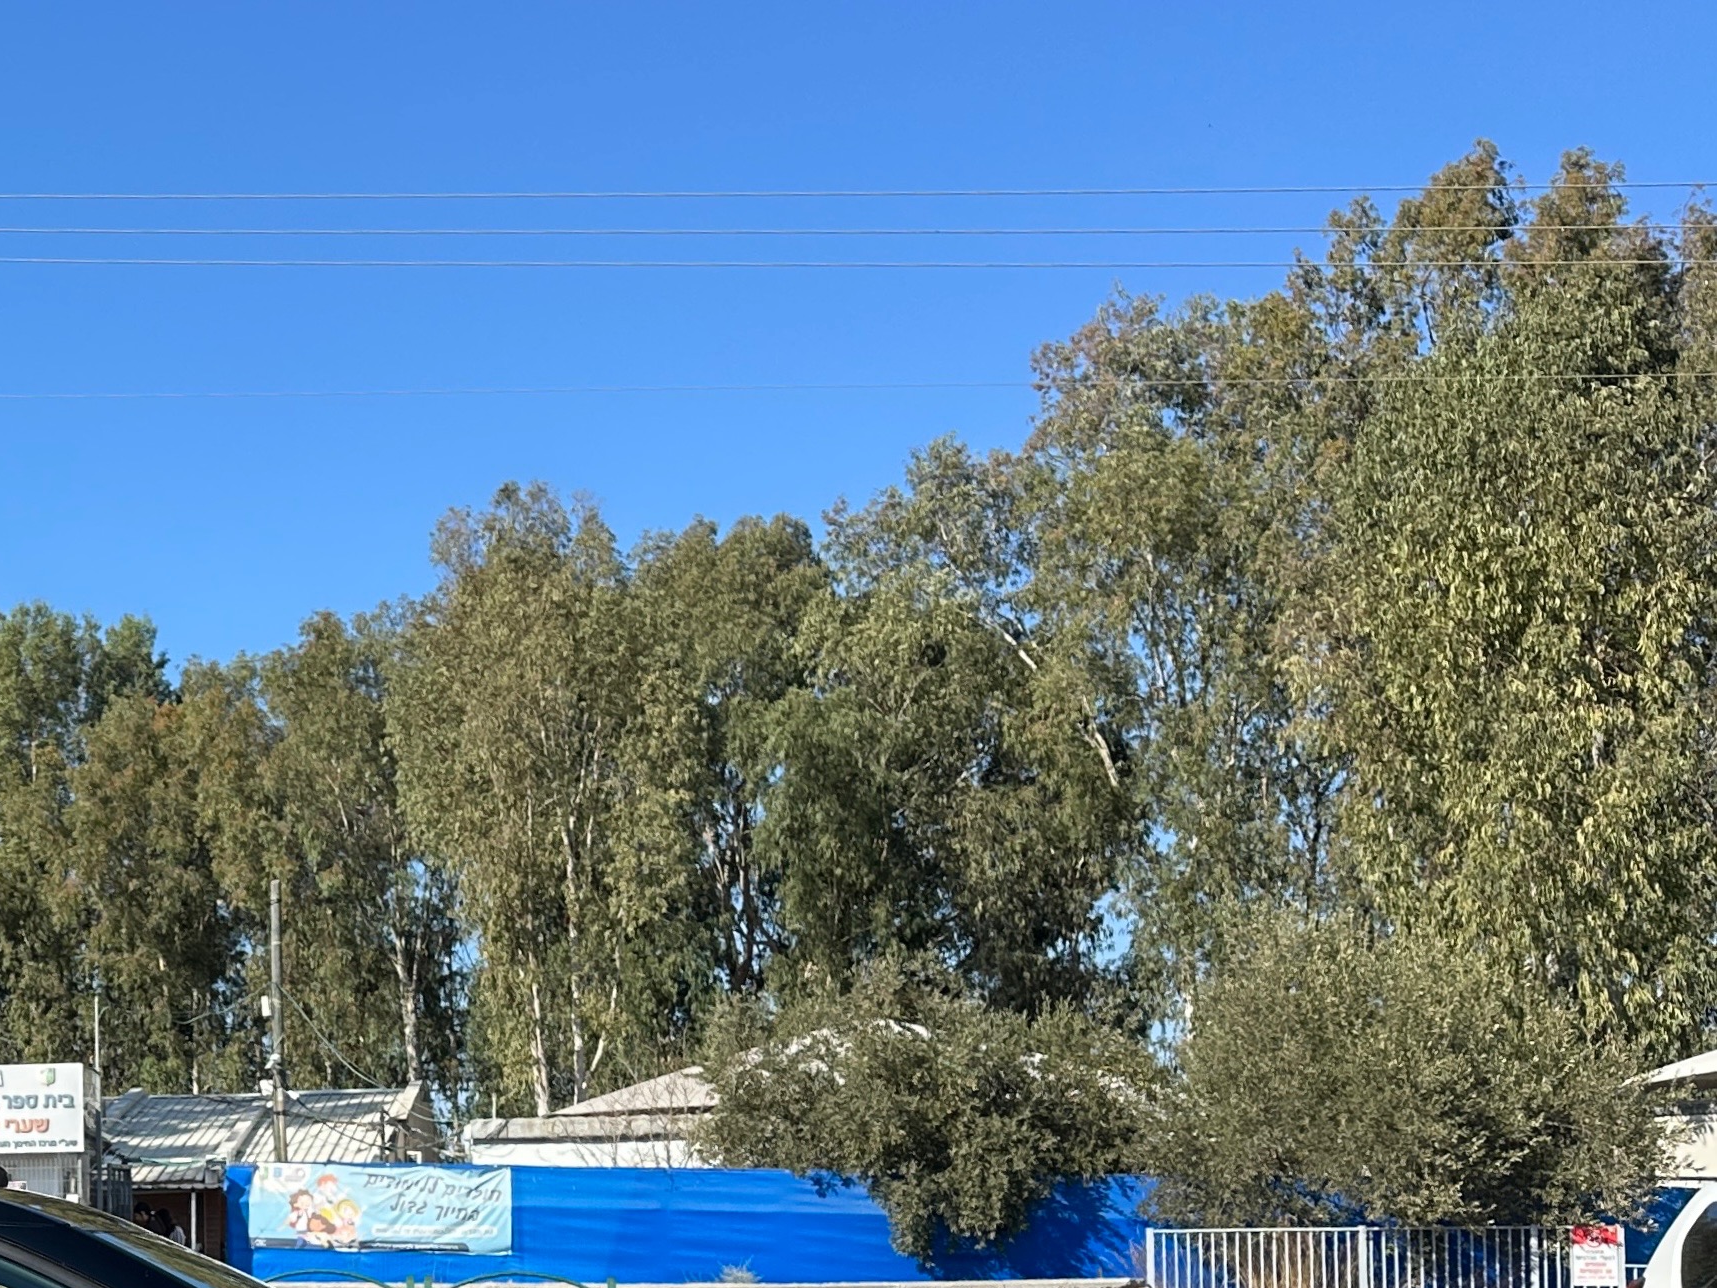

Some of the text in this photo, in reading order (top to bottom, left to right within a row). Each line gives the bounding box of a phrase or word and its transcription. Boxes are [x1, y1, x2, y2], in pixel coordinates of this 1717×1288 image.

[2, 1094, 39, 1110] ספר
[43, 1093, 76, 1110] בית
[5, 1117, 51, 1134] שערי
[363, 1173, 444, 1194] ללימודים
[390, 1193, 428, 1214] גדול
